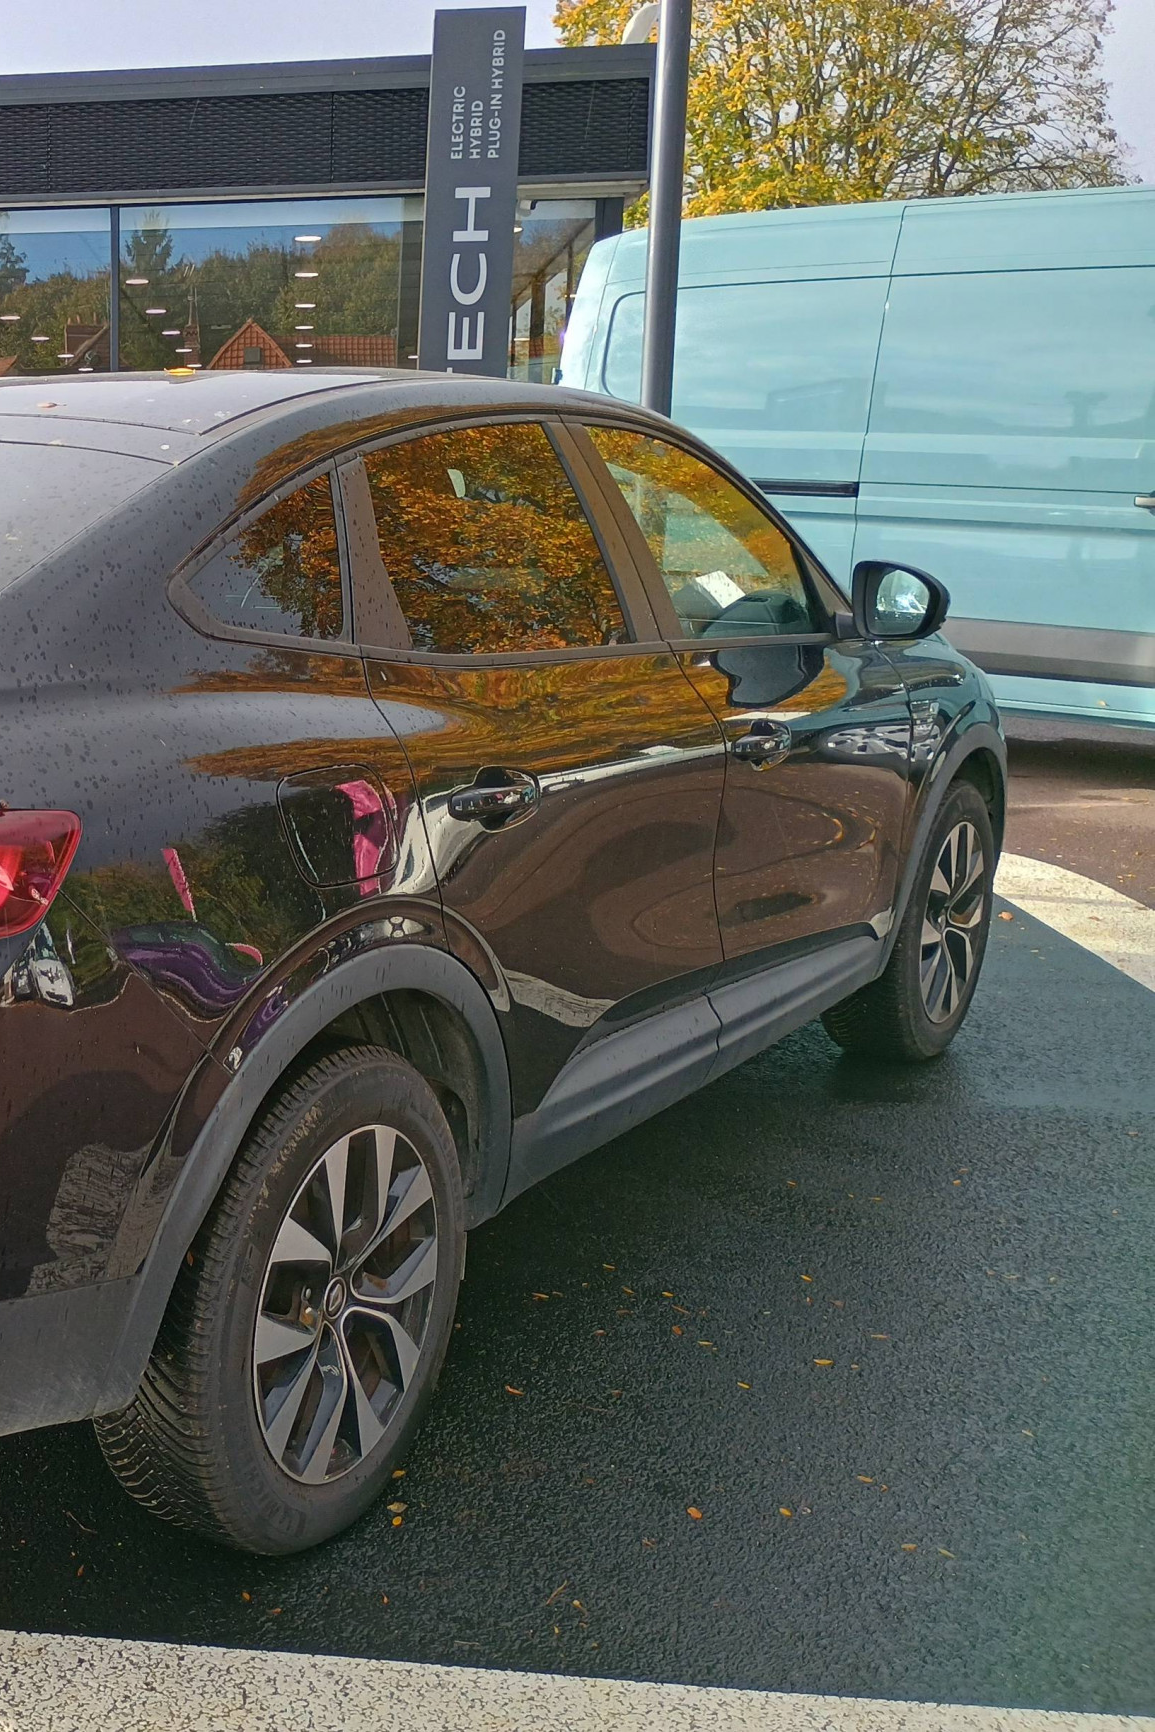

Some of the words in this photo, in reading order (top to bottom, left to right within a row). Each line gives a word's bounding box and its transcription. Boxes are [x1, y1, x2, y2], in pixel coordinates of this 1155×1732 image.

[491, 29, 506, 89] HYBRID
[450, 86, 466, 160] ELECTRIC
[469, 100, 484, 159] HYBRID
[487, 94, 502, 158] PLUG-IN
[446, 186, 491, 372] ECH
